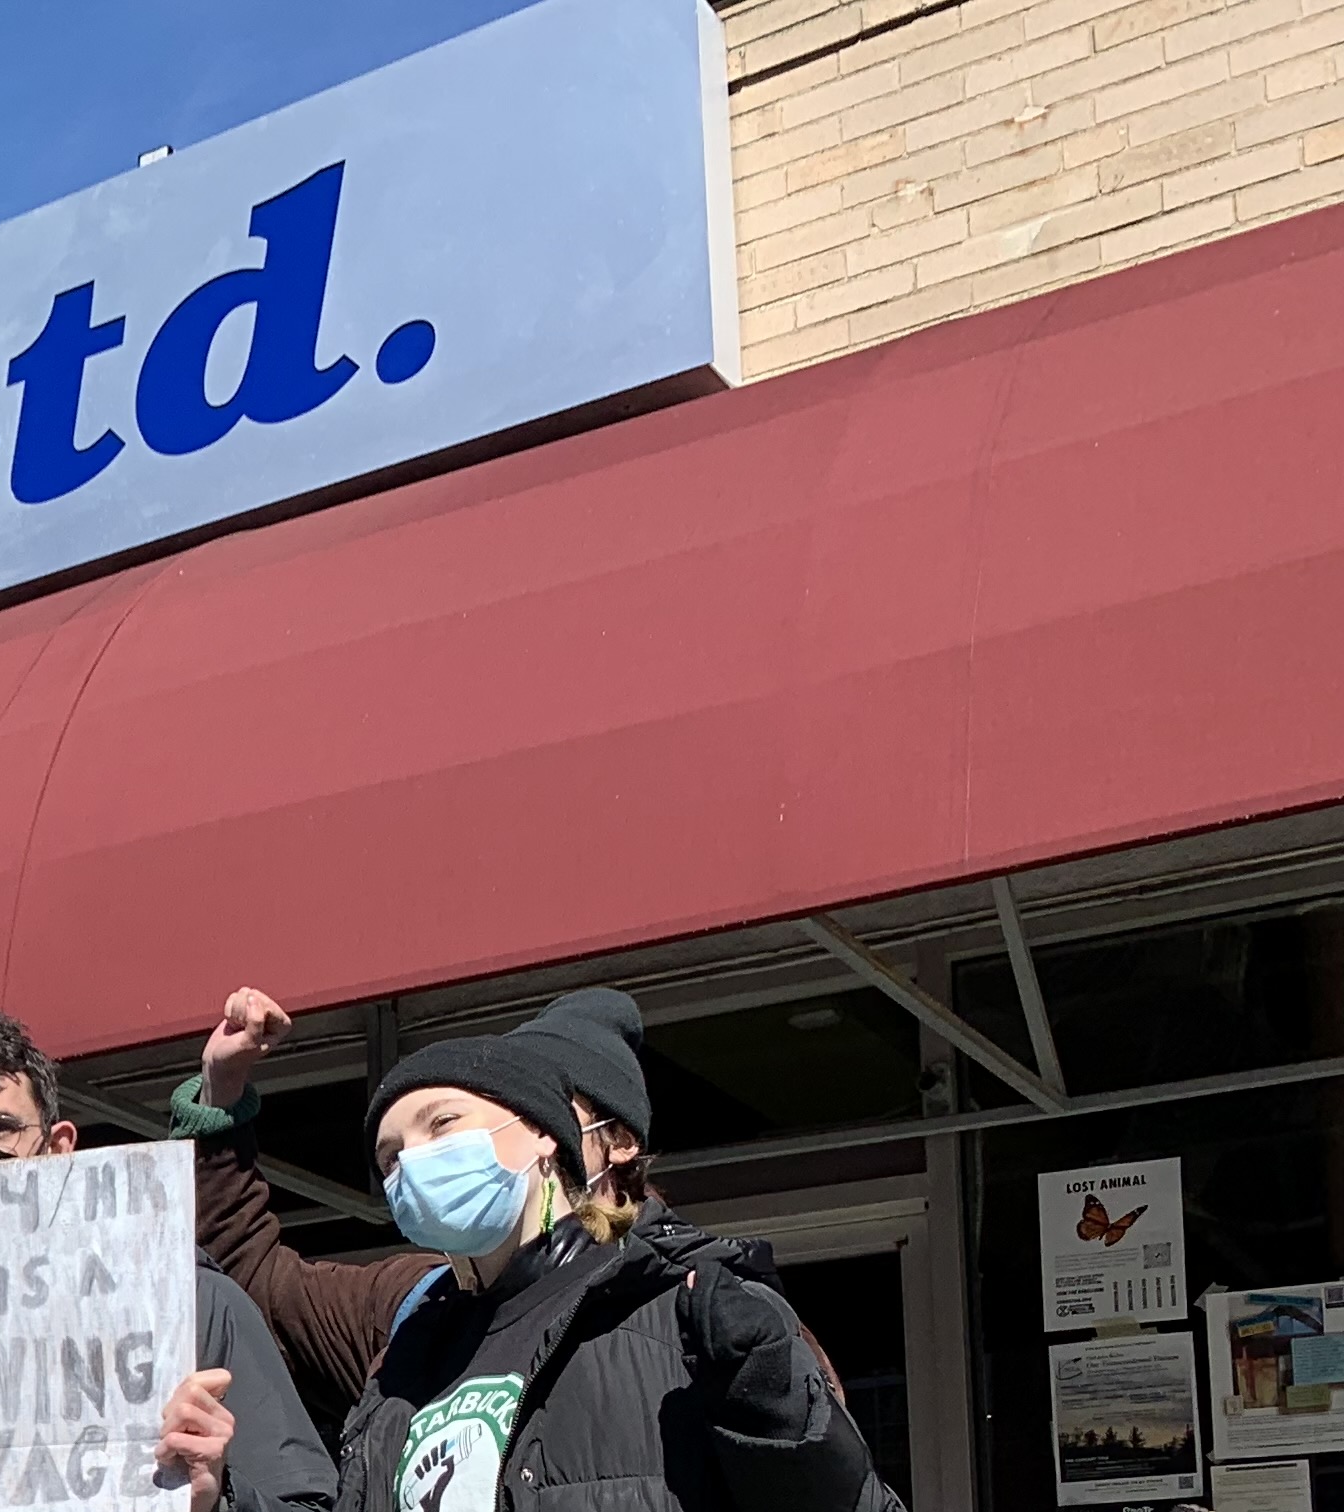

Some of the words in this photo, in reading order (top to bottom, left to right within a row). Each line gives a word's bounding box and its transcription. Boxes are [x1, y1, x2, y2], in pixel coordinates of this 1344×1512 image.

[1066, 1180, 1095, 1194] LOST
[1100, 1175, 1146, 1190] ANIMAL
[79, 1252, 116, 1297] A
